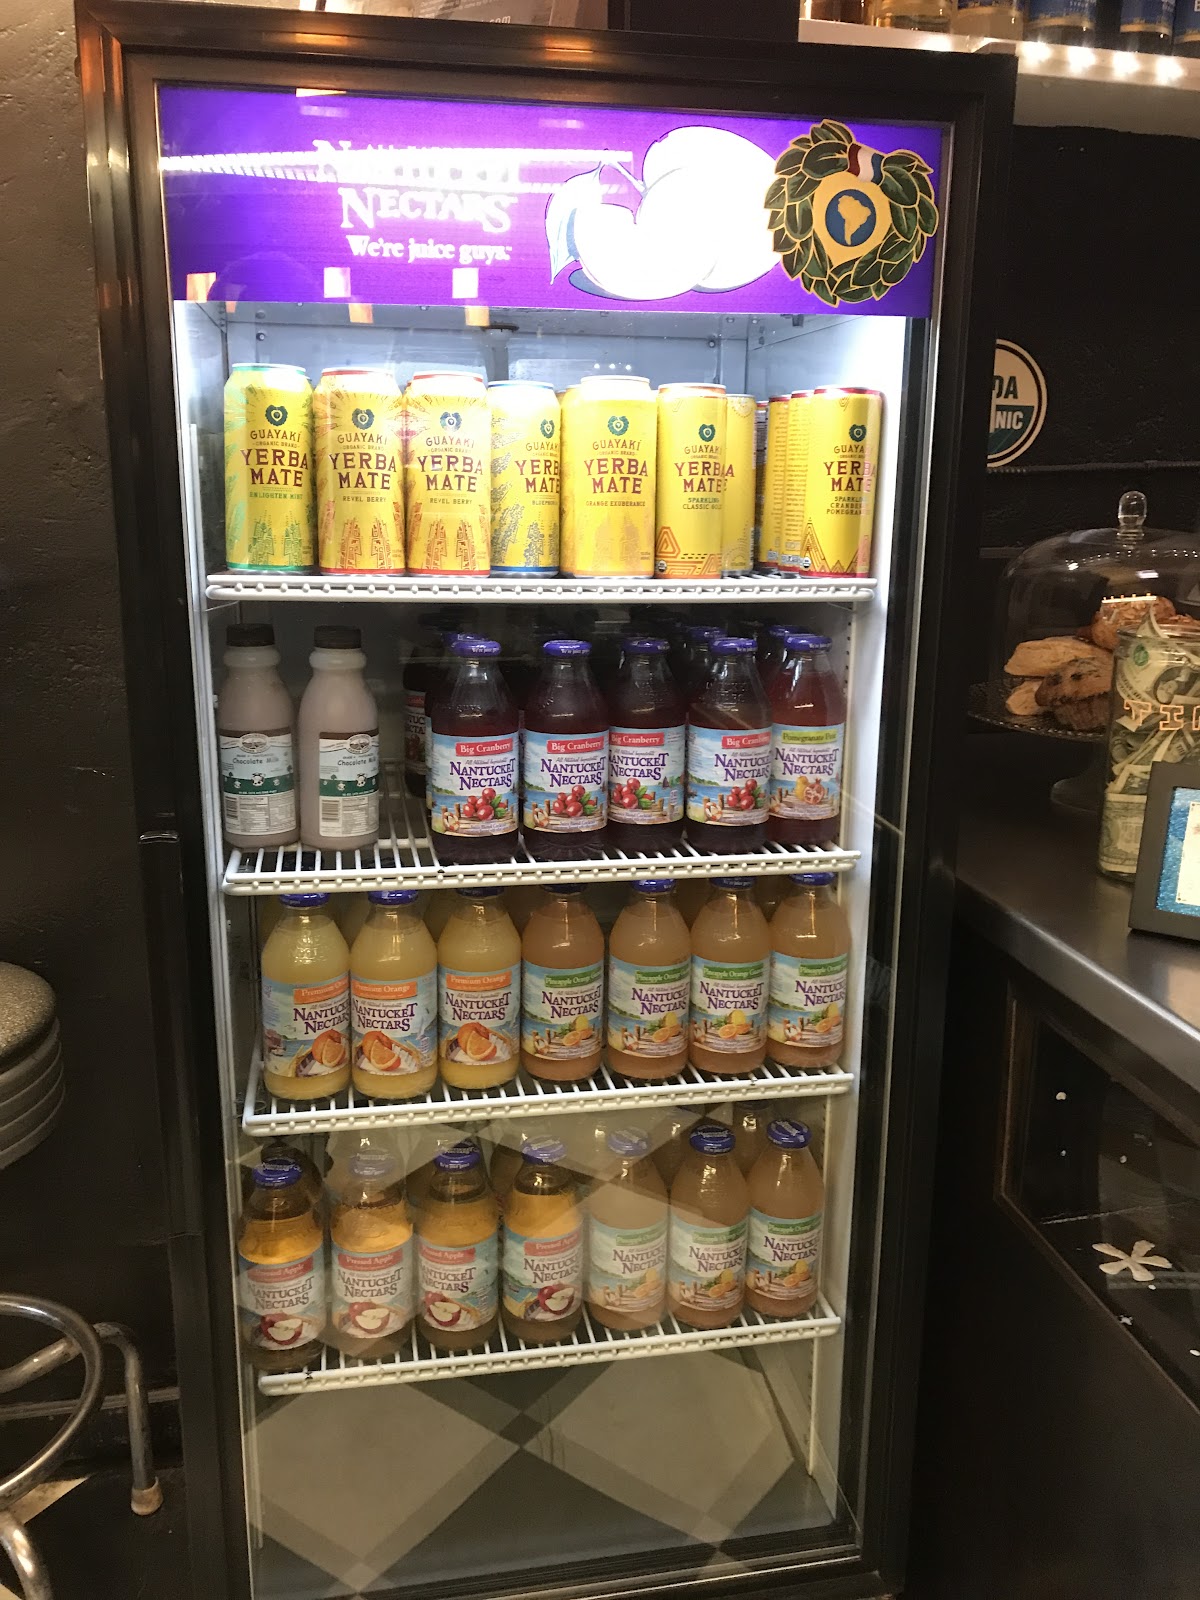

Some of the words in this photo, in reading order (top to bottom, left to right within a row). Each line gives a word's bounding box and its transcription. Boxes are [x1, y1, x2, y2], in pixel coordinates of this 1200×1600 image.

[338, 187, 518, 232] NECTARS
[346, 235, 404, 257] We're
[407, 237, 455, 263] juice
[240, 449, 309, 470] YERBA
[328, 452, 397, 473] YERBA
[417, 455, 483, 475] YERBA
[584, 458, 648, 477] YERBA
[251, 468, 304, 487] MATE
[338, 471, 391, 490] MATE
[425, 474, 478, 493] MATE
[592, 476, 642, 494] MATE
[683, 478, 722, 493] MATE
[831, 476, 872, 492] MATE
[525, 478, 560, 494] MATE
[342, 495, 362, 503] REVEL
[611, 734, 621, 745] Big
[622, 735, 661, 745] Cranberry
[726, 737, 740, 747] Big
[783, 732, 824, 742] Pomegranate
[460, 744, 475, 754] Big
[476, 743, 511, 752] Cranberry
[551, 742, 566, 752] Big
[567, 740, 601, 750] Cranberry
[232, 757, 263, 765] Chocolate
[775, 747, 839, 763] NANTUCKET
[449, 758, 516, 775] NANTUCKET
[540, 756, 607, 773] NANTUCKET
[610, 764, 662, 780] NECTARS
[782, 762, 834, 776] NECTARS
[550, 771, 603, 787] NECTARS
[724, 765, 770, 781] NECTARS
[459, 774, 512, 790] NECTARS
[451, 975, 481, 984] Premium
[483, 975, 507, 984] Orange
[301, 986, 333, 997] Premium
[383, 985, 410, 993] Orange
[542, 984, 602, 1004] NANTUCKET
[700, 981, 764, 998] NANTUCKET
[352, 999, 418, 1017] NANTUCKET
[445, 991, 512, 1009] NANTUCKET
[640, 999, 687, 1014] NECTARS
[707, 996, 759, 1010] NECTARS
[452, 1007, 506, 1021] NECTARS
[550, 1000, 599, 1018] NECTARS
[357, 1015, 411, 1031] NECTARS
[373, 1254, 394, 1264] Apple
[444, 1251, 464, 1260] Apple
[337, 1267, 404, 1287] NANTUCKET
[248, 1276, 315, 1298] NANTUCKET
[344, 1283, 398, 1298] NECTARS
[255, 1292, 309, 1310] NECTARS
